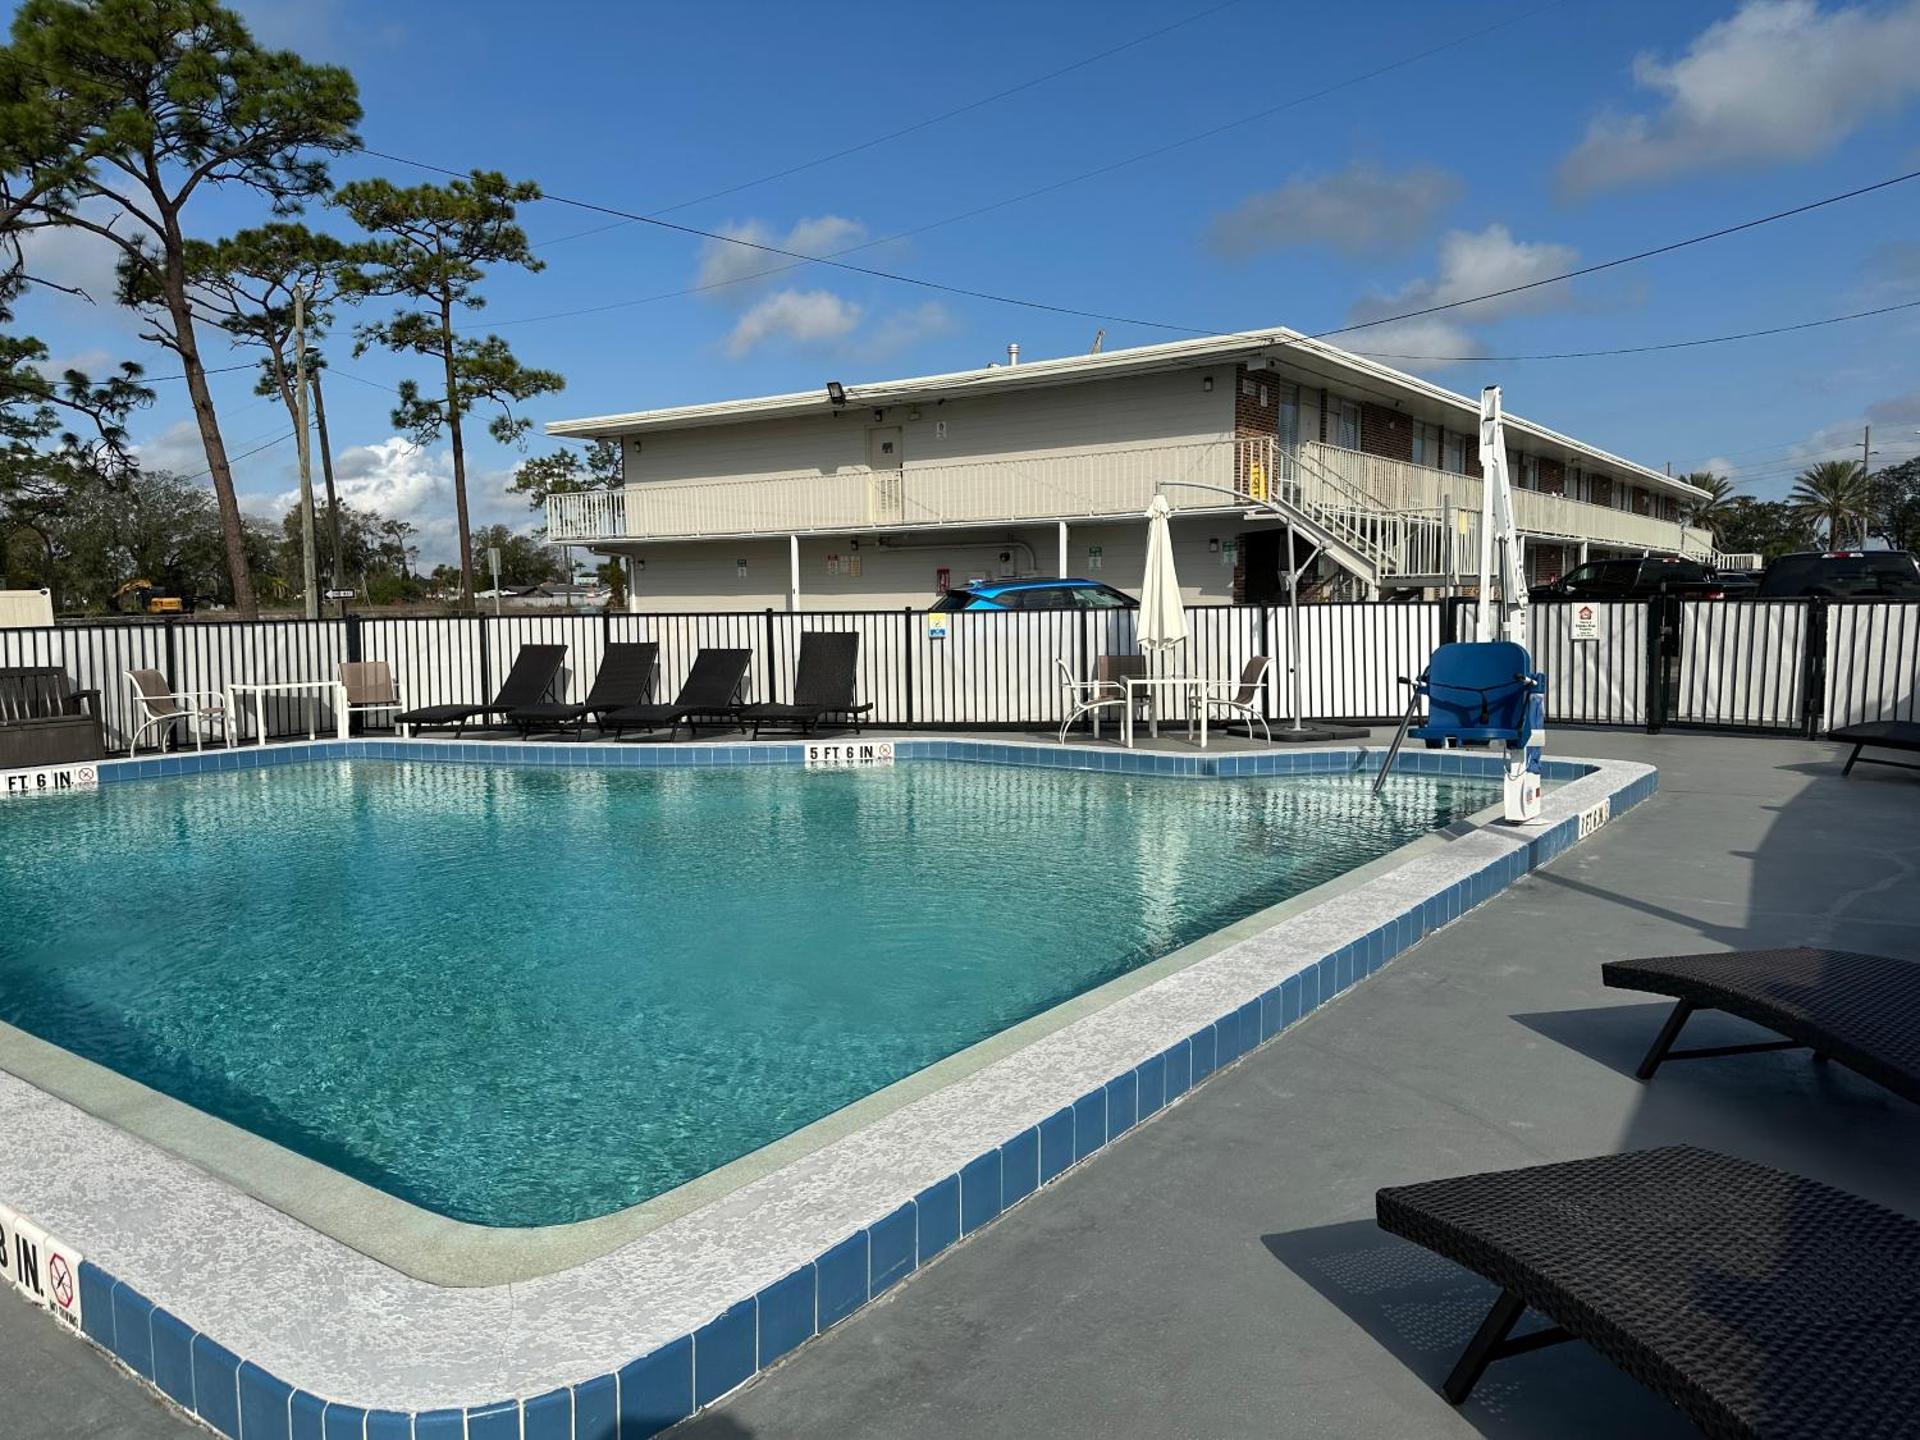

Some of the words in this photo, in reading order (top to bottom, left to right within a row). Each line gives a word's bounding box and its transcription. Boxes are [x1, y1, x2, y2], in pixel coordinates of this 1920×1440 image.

[810, 747, 818, 759] 5
[824, 746, 839, 759] FT
[846, 746, 854, 758] 6
[36, 773, 46, 788] 6
